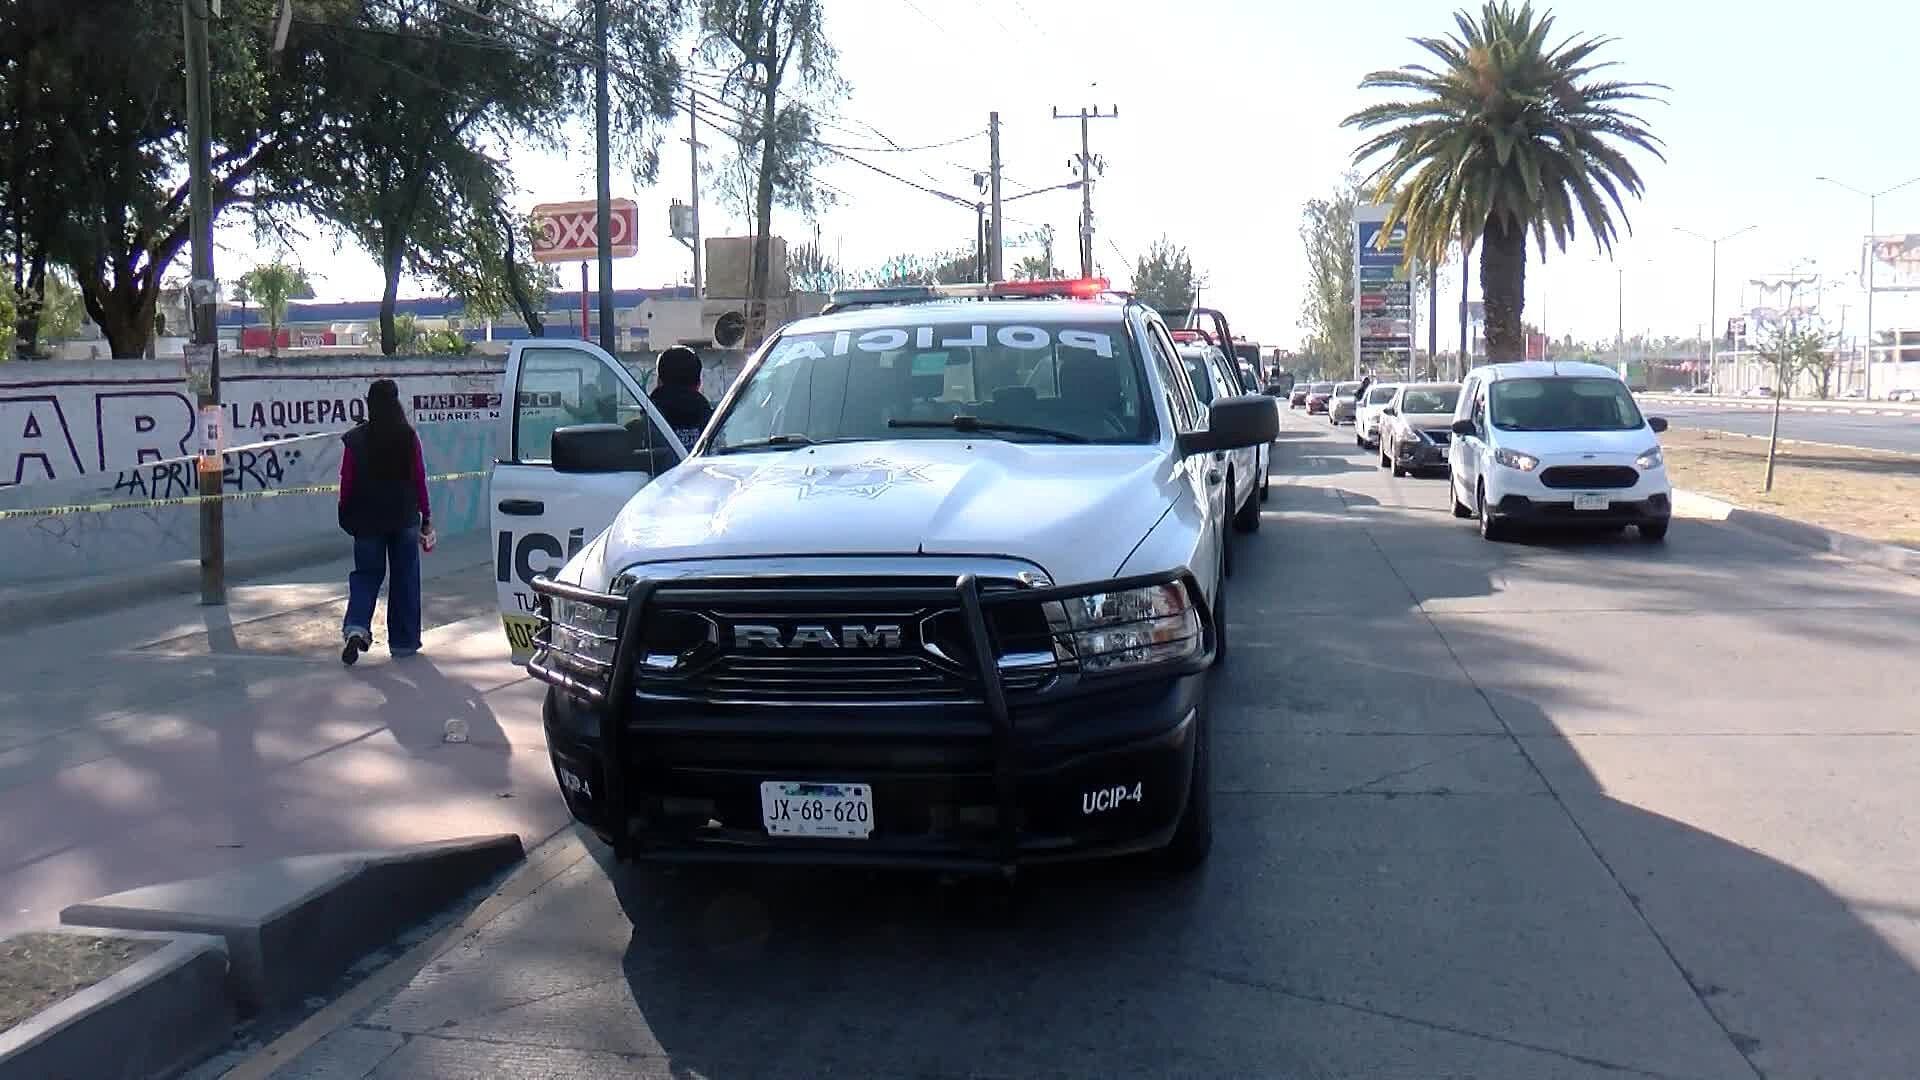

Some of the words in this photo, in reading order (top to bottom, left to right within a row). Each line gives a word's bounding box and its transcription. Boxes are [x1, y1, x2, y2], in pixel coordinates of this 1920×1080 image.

[455, 394, 473, 409] DE
[221, 399, 368, 429] LAQUEPAQ
[734, 625, 901, 648] RAM
[1083, 781, 1143, 814] UCIP-4
[769, 799, 868, 822] JX-68-620
